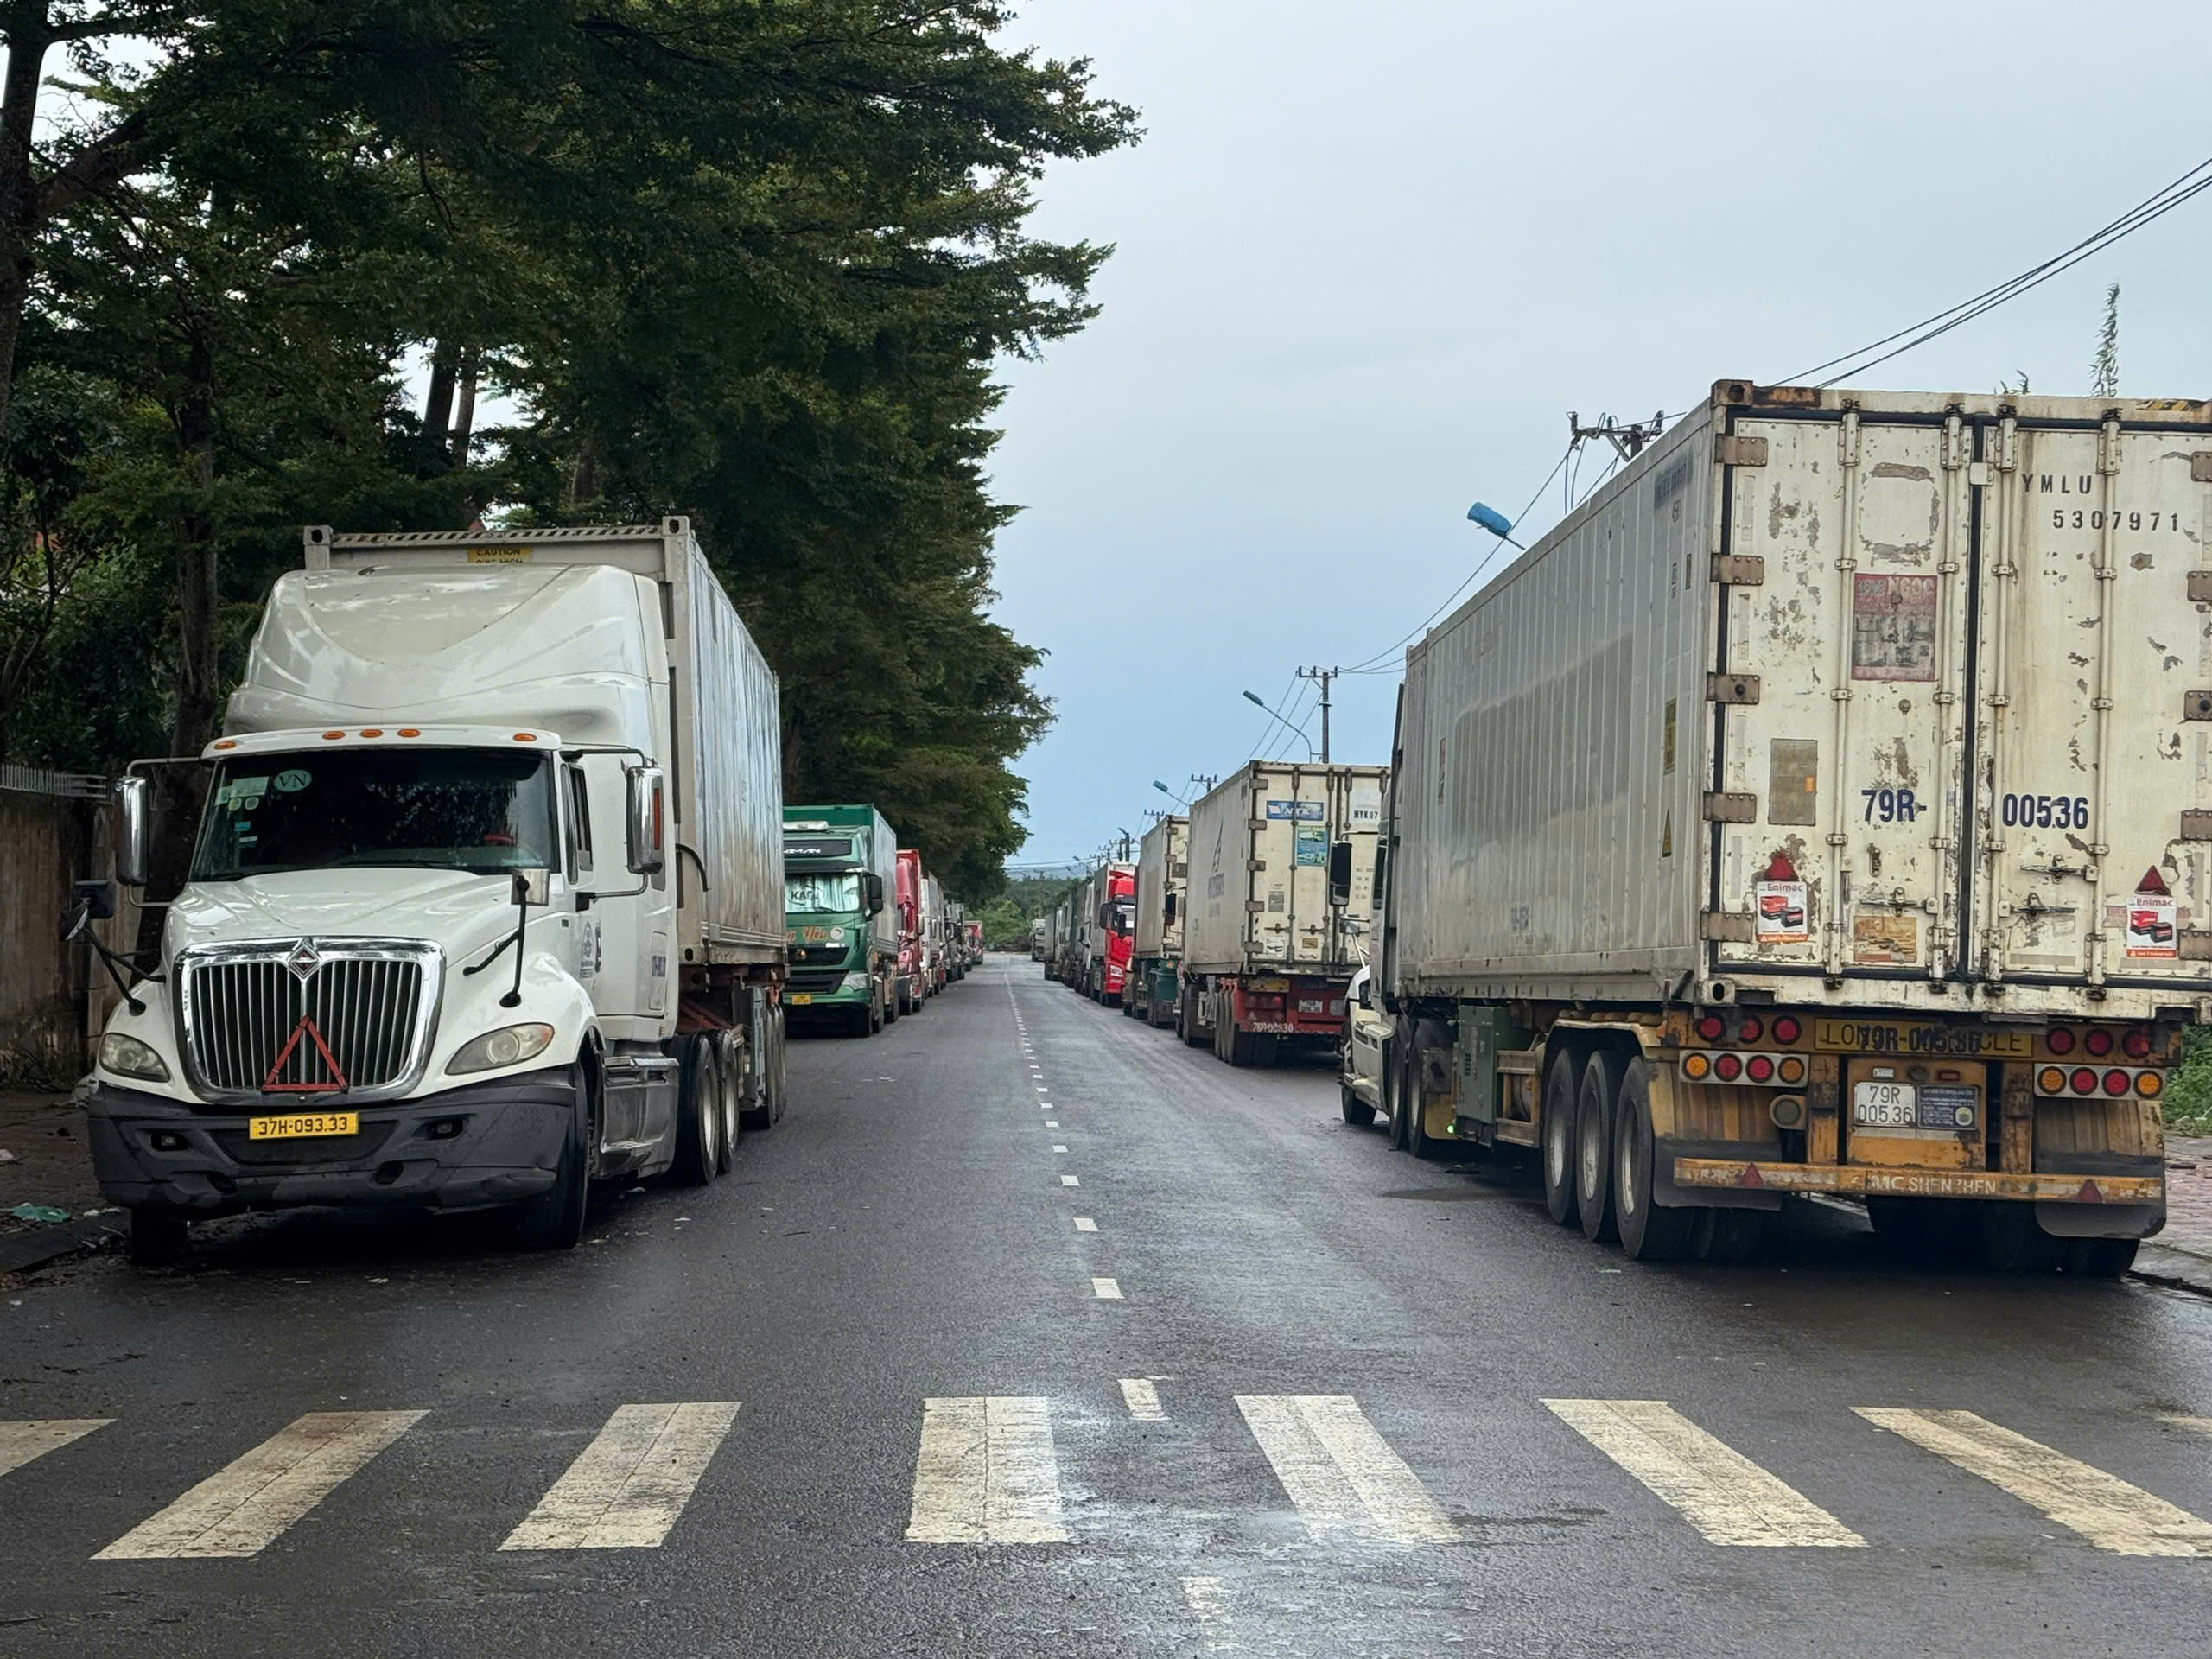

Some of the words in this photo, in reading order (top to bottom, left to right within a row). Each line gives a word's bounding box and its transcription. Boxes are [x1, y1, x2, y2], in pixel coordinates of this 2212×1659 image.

[2021, 474, 2093, 495] YMLU
[2052, 509, 2178, 532] 5307971
[476, 548, 520, 556] CAUTION
[278, 773, 307, 788] VN
[1869, 1085, 1901, 1104] 79R
[1858, 1104, 1913, 1123] 005.36
[258, 1116, 348, 1135] 37H-093.33
